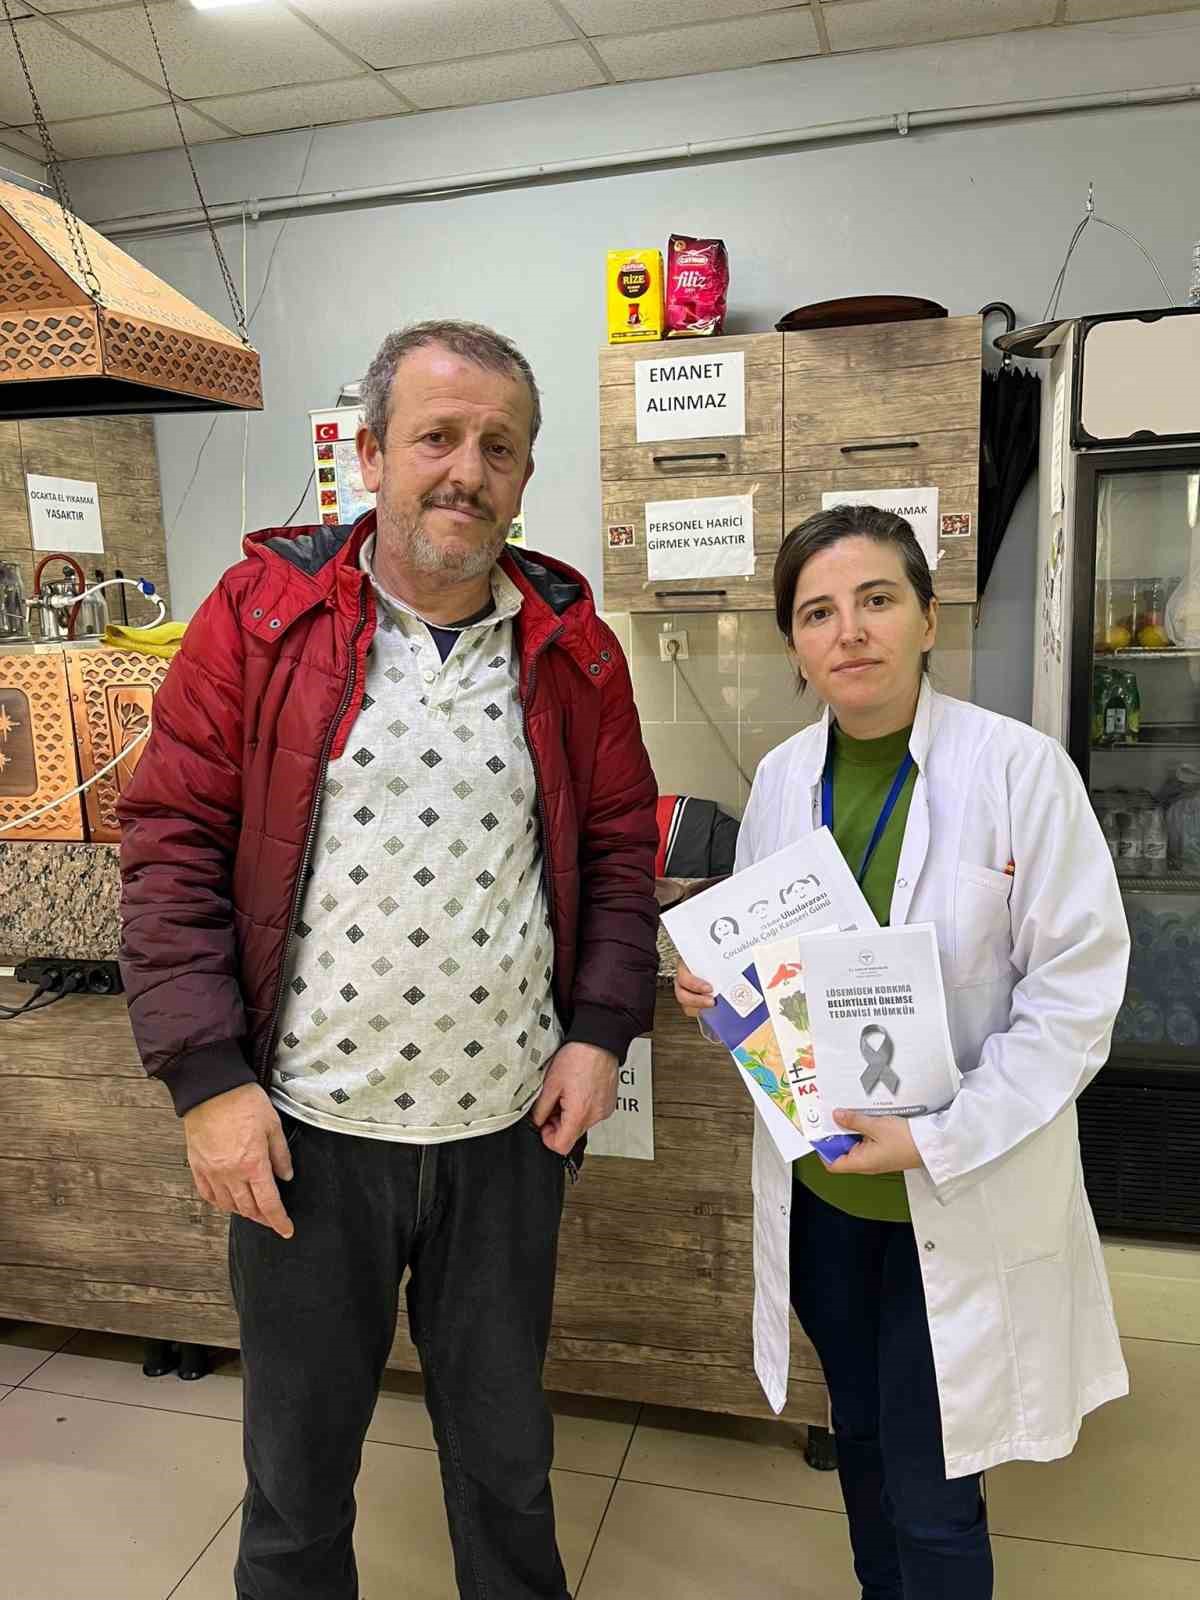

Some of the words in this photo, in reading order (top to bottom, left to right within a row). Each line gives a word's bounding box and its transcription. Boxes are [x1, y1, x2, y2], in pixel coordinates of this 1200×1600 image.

[650, 363, 723, 382] EMANET
[647, 393, 727, 412] ALINMAZ
[30, 490, 56, 501] OCAKTA
[57, 491, 64, 502] EL
[46, 508, 85, 520] YASAKTIR
[880, 505, 928, 516] IKAMAK
[649, 519, 703, 533] PERSONEL
[706, 514, 743, 529] HARİCİ
[648, 537, 690, 550] GİRMEK
[692, 534, 745, 547] YASAKTIR
